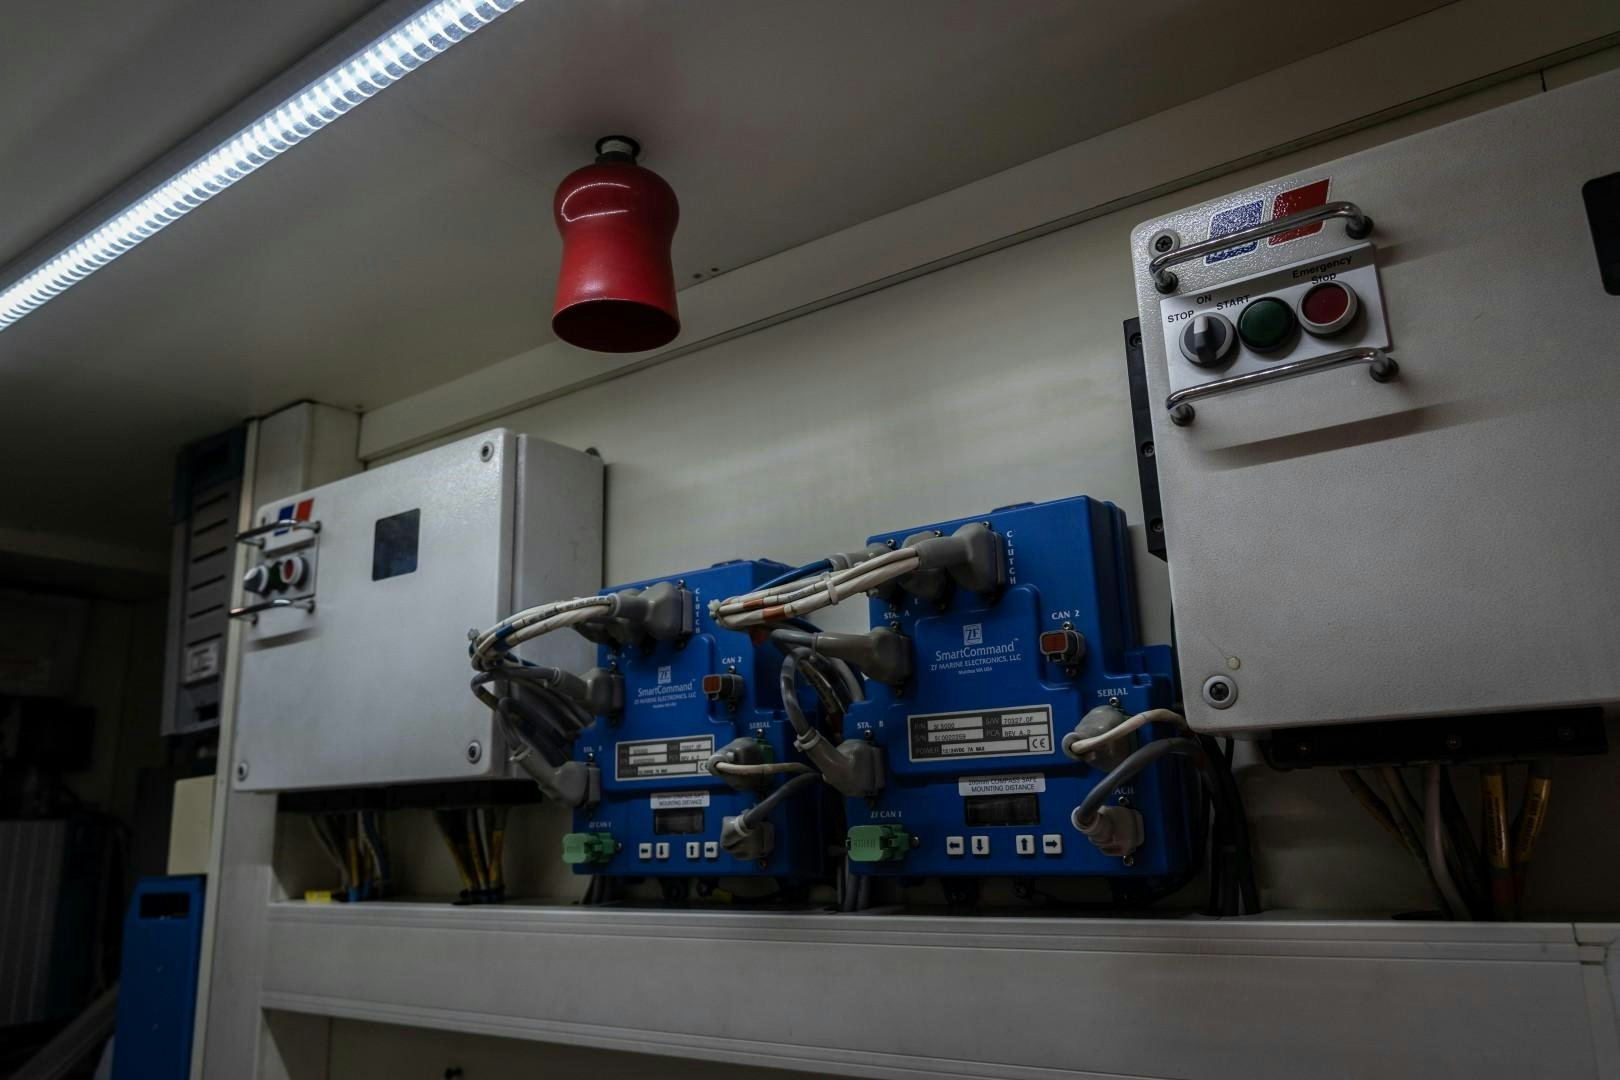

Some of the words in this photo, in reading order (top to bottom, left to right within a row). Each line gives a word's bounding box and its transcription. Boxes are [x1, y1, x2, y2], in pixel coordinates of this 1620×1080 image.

[1292, 256, 1353, 279] Emergency
[1311, 273, 1337, 285] Stop
[1196, 294, 1212, 305] ON
[1216, 294, 1251, 311] START
[1167, 309, 1195, 323] STOP
[1007, 530, 1017, 585] CLUTCH
[1051, 611, 1071, 620] CAN
[1074, 609, 1080, 617] 2
[936, 640, 1016, 662] SmartCommand
[938, 660, 963, 670] MARINE
[1009, 654, 1022, 662] LLC
[1097, 687, 1129, 697] SERIAL
[971, 784, 1004, 793] MOUNTING
[1005, 783, 1036, 792] DISTANCE
[1112, 786, 1134, 796] ACH
[879, 809, 897, 819] CAN
